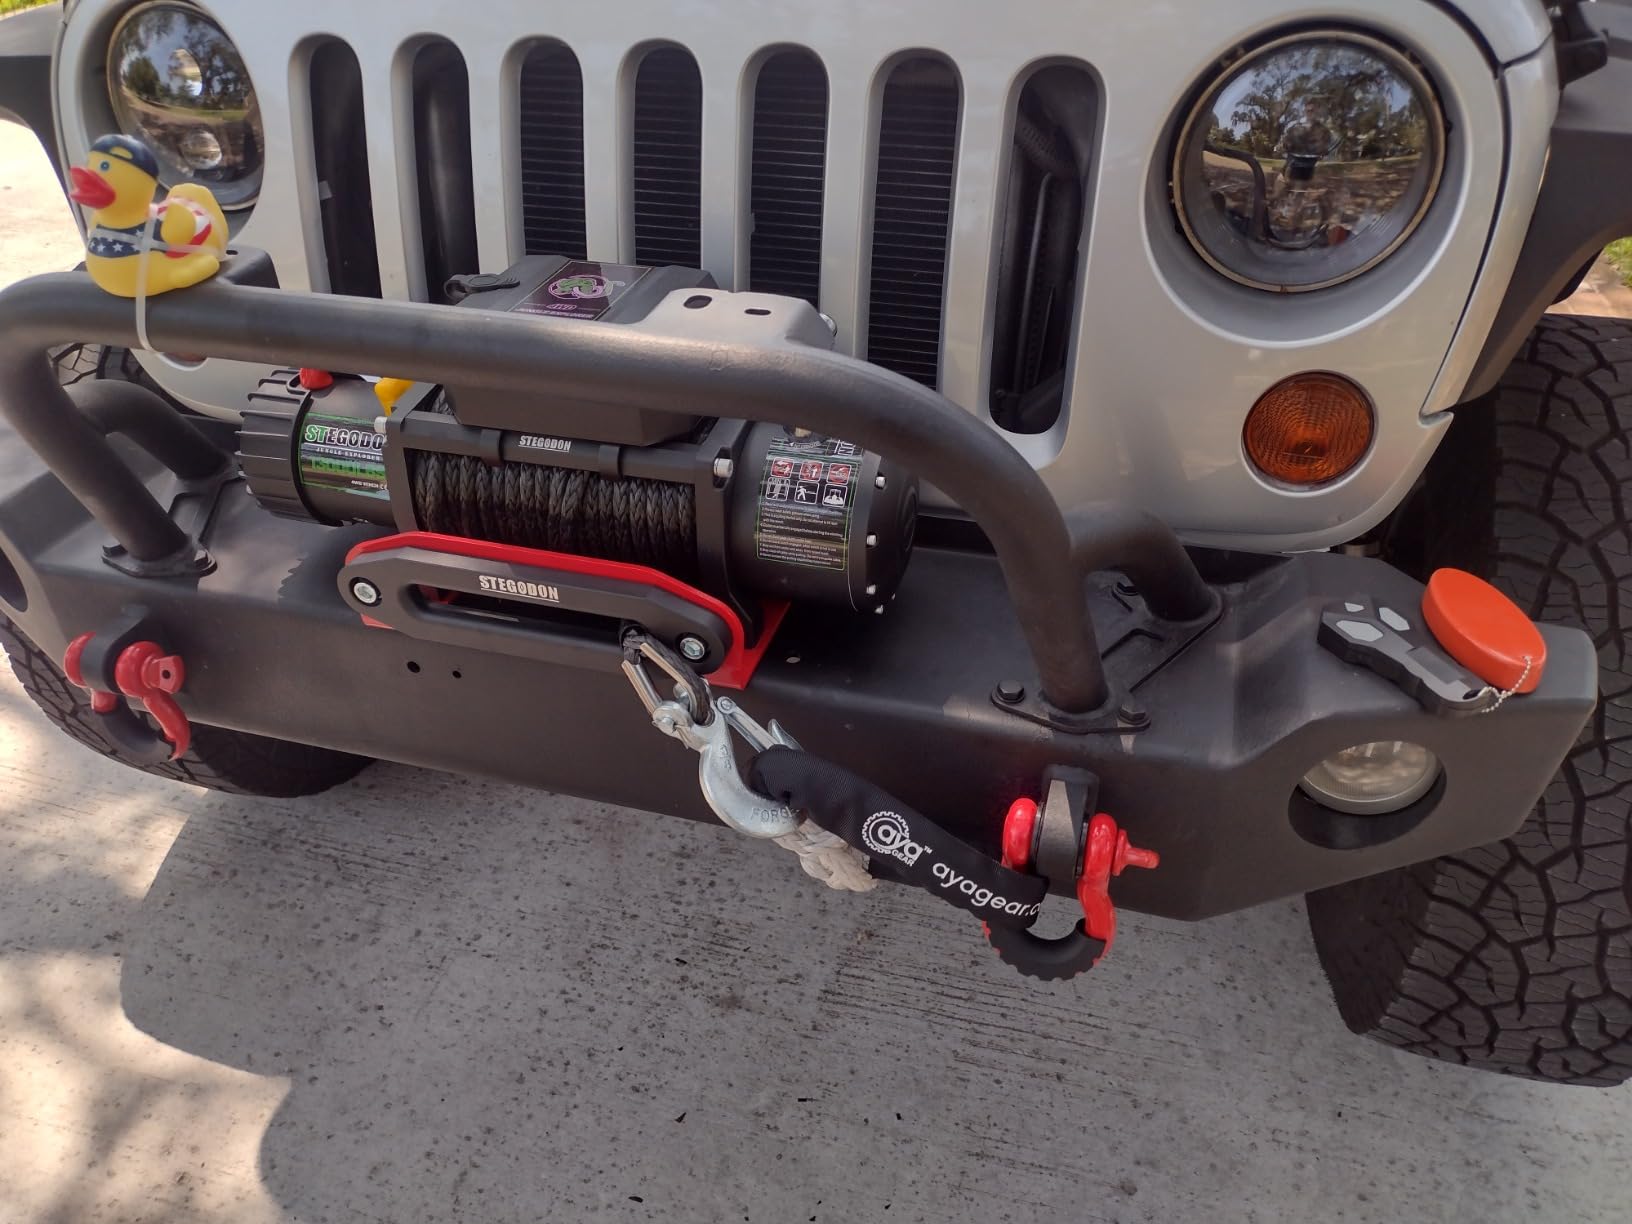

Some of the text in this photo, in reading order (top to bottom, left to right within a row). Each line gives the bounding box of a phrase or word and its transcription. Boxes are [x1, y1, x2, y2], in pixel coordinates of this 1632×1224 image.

[305, 424, 387, 451] STEGODO
[519, 435, 572, 452] STEGODON
[478, 575, 560, 601] STEGODON
[891, 849, 915, 867] GEAR
